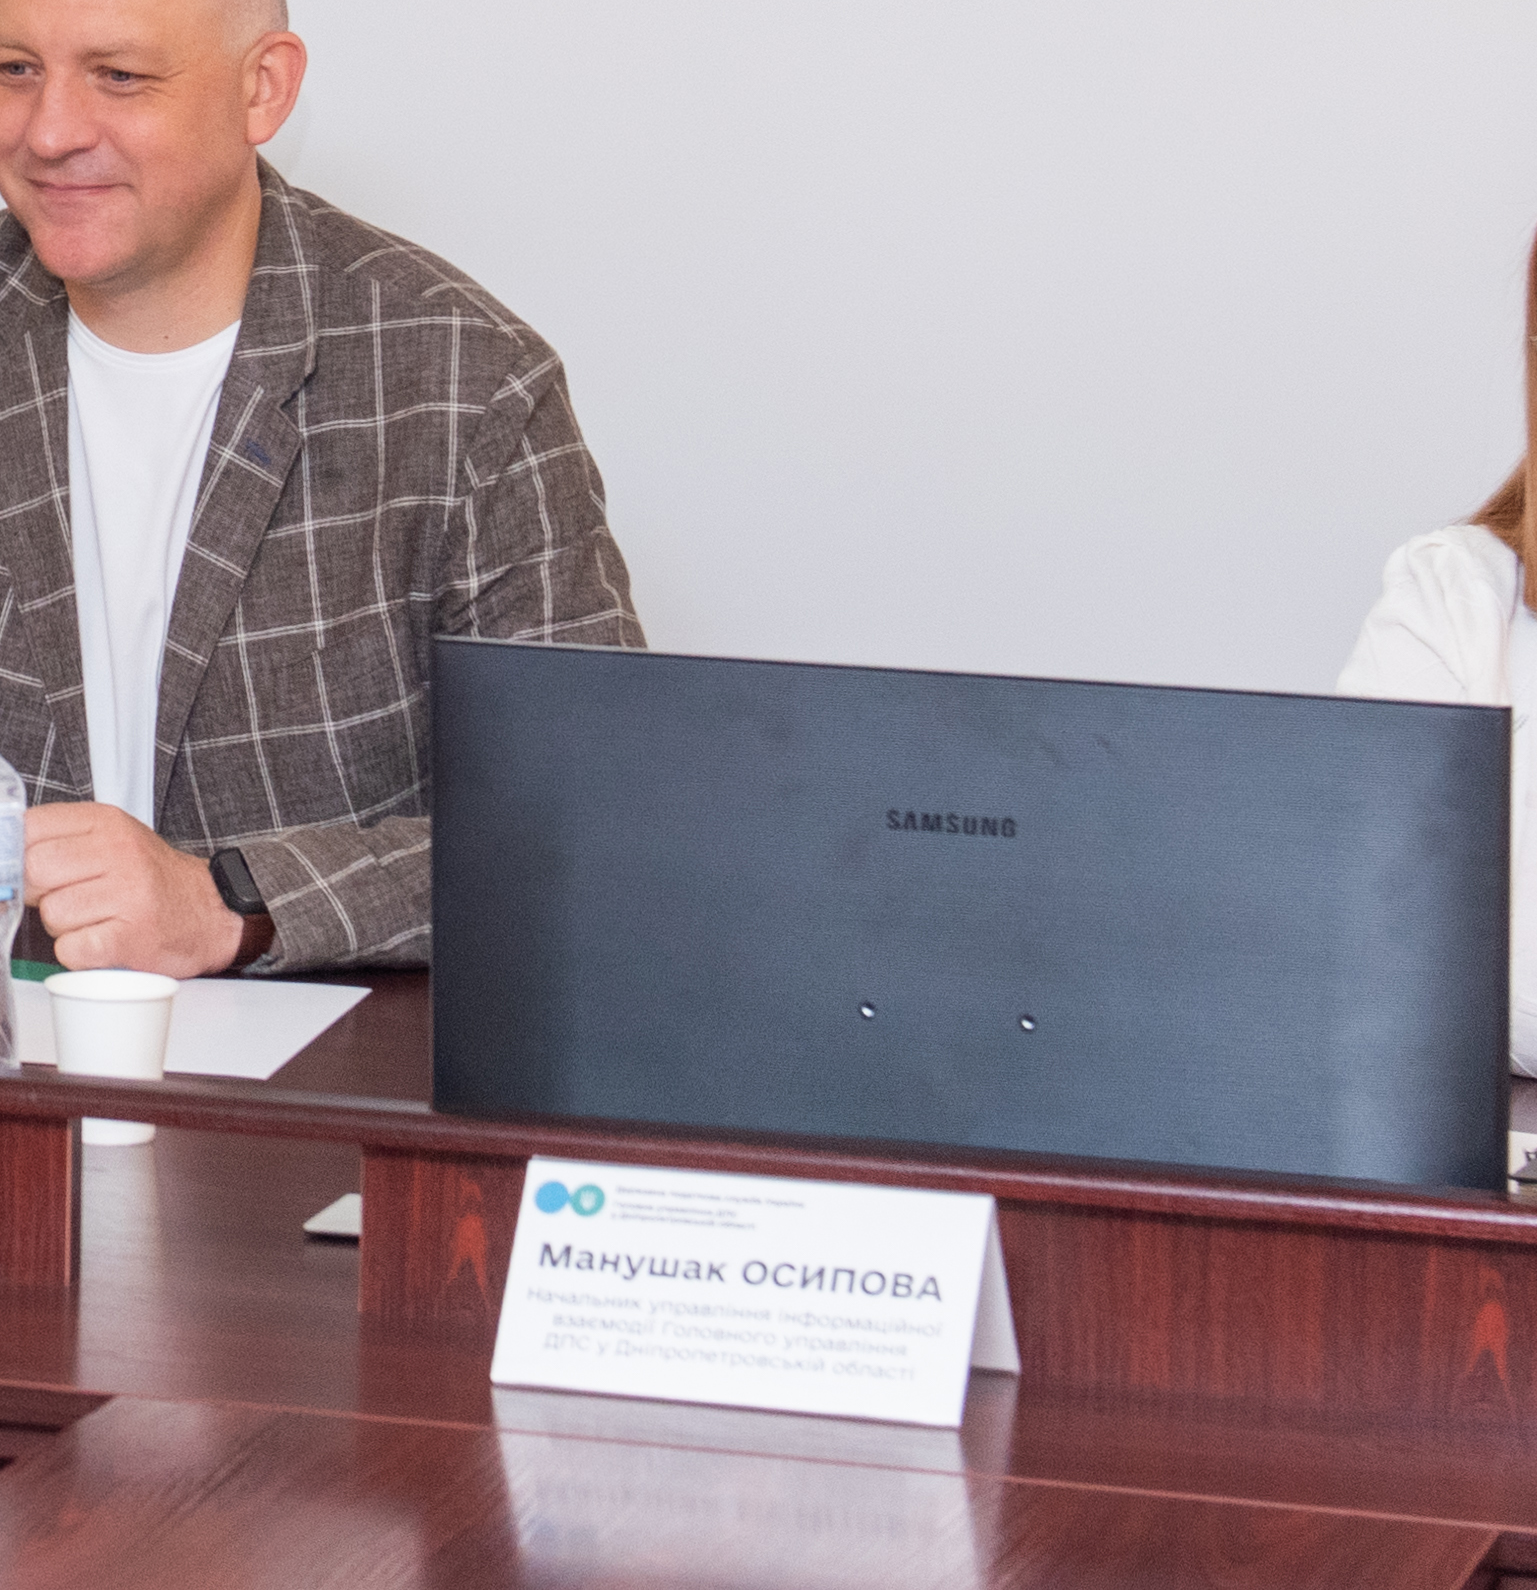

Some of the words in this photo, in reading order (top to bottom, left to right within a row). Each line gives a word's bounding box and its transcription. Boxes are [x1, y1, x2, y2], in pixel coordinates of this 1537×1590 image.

[885, 809, 1017, 838] SAMSUNG
[537, 1241, 727, 1282] Манушак
[740, 1259, 943, 1303] ОСИПОВА
